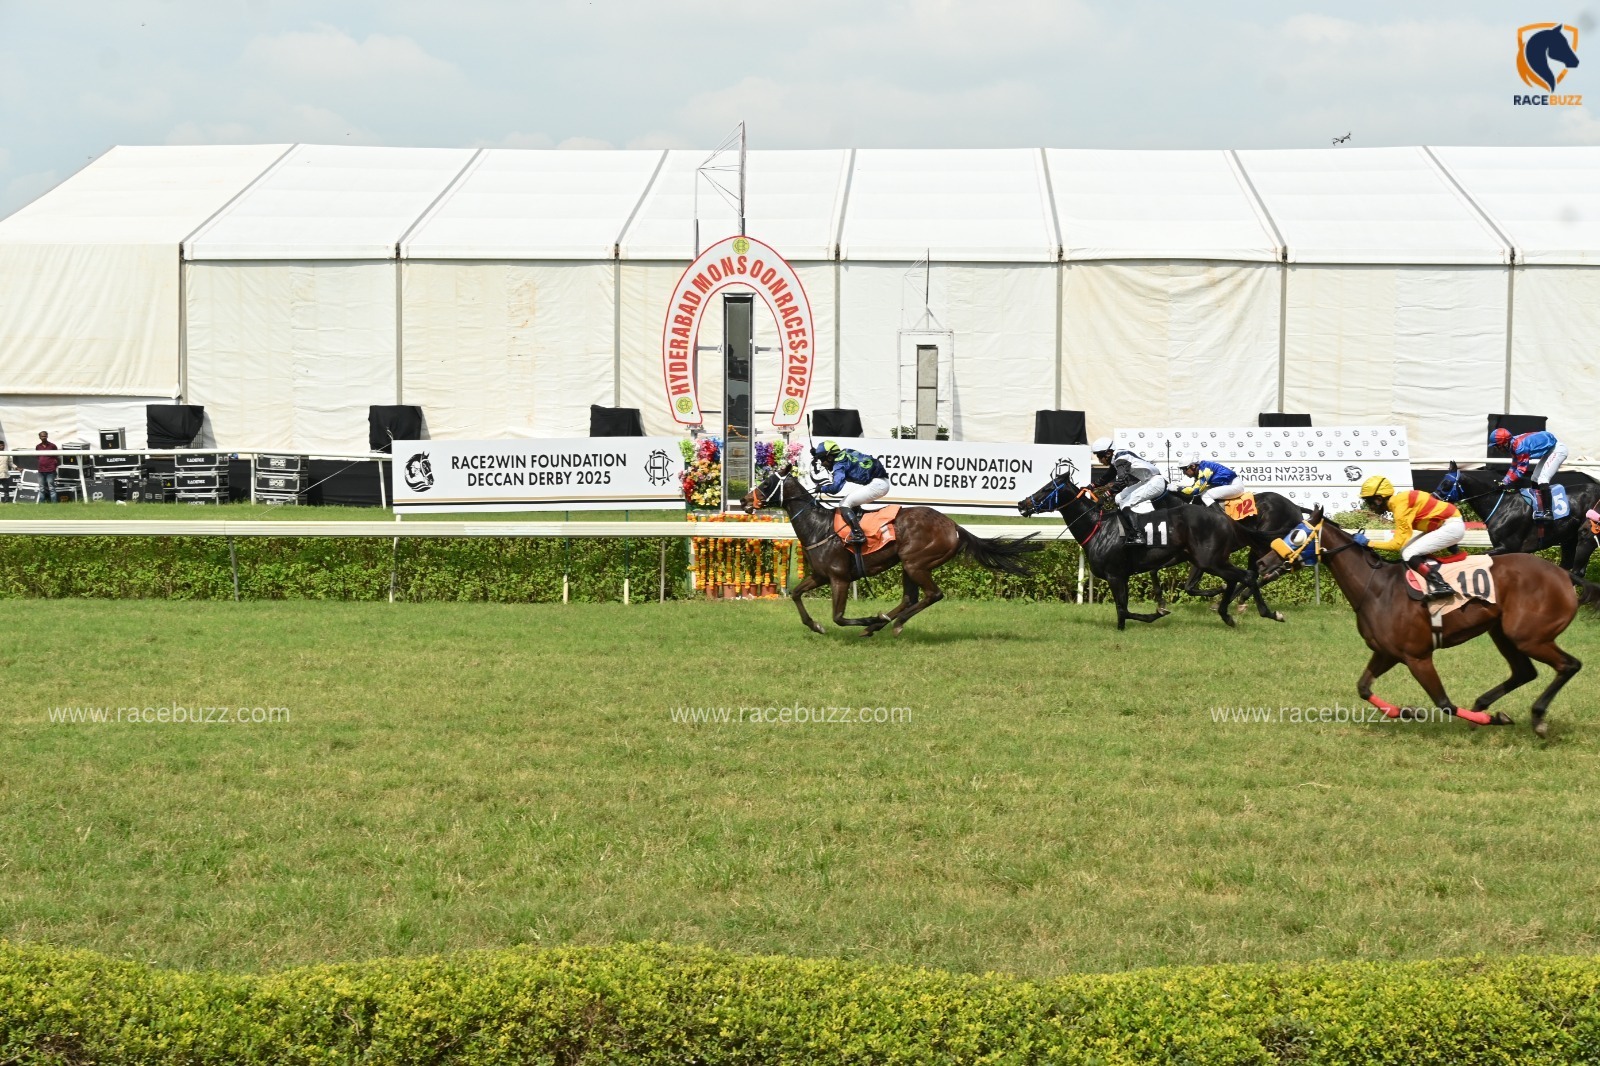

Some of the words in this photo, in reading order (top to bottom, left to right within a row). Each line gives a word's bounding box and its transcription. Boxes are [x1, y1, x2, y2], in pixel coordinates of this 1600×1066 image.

[669, 290, 702, 396] HYDERABAD
[451, 455, 527, 470] RACE2WIN
[531, 453, 627, 468] FOUNDATION
[936, 456, 1033, 473] FOUNDATION
[1239, 466, 1272, 474] DERBY
[1275, 466, 1318, 474] DECCAN
[467, 472, 525, 487] DECCAN
[529, 471, 572, 486] DERBY
[576, 470, 611, 485] 2025
[886, 472, 929, 487] CCAN
[933, 474, 978, 489] DERBY
[981, 475, 1017, 490] 2025
[1235, 498, 1255, 519] 12
[1552, 493, 1568, 515] 5
[1144, 521, 1168, 546] 11
[1456, 568, 1491, 599] 10
